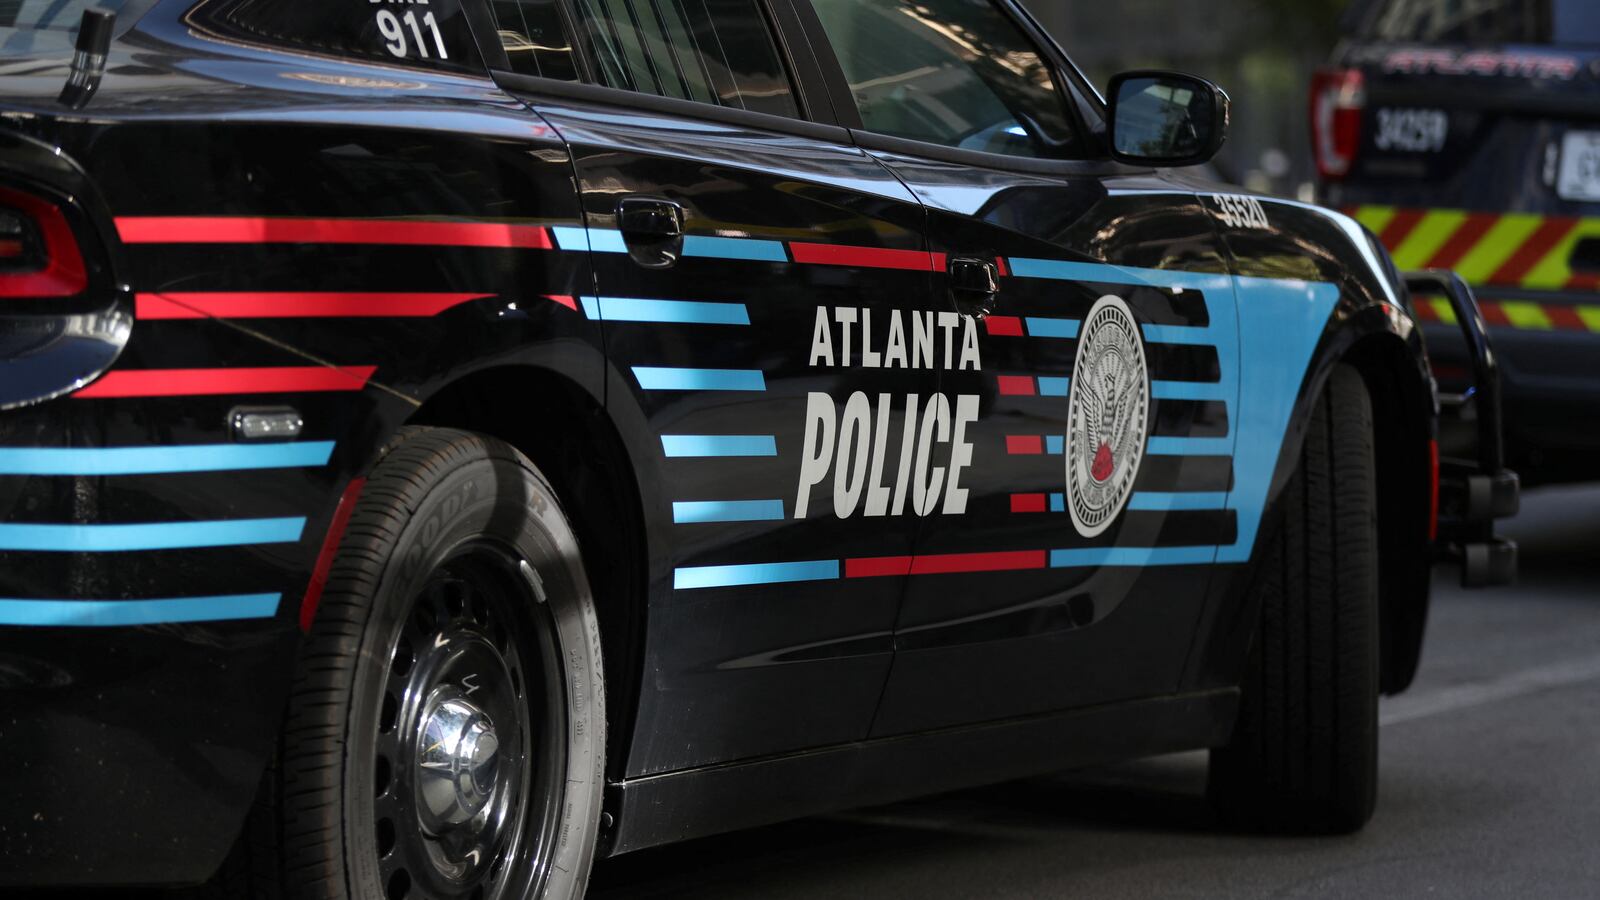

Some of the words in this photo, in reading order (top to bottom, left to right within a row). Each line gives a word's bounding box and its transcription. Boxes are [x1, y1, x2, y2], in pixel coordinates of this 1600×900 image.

[376, 9, 448, 59] 911
[1213, 194, 1269, 228] 35520
[809, 305, 982, 371] ATLANTA
[793, 390, 981, 519] POLICE
